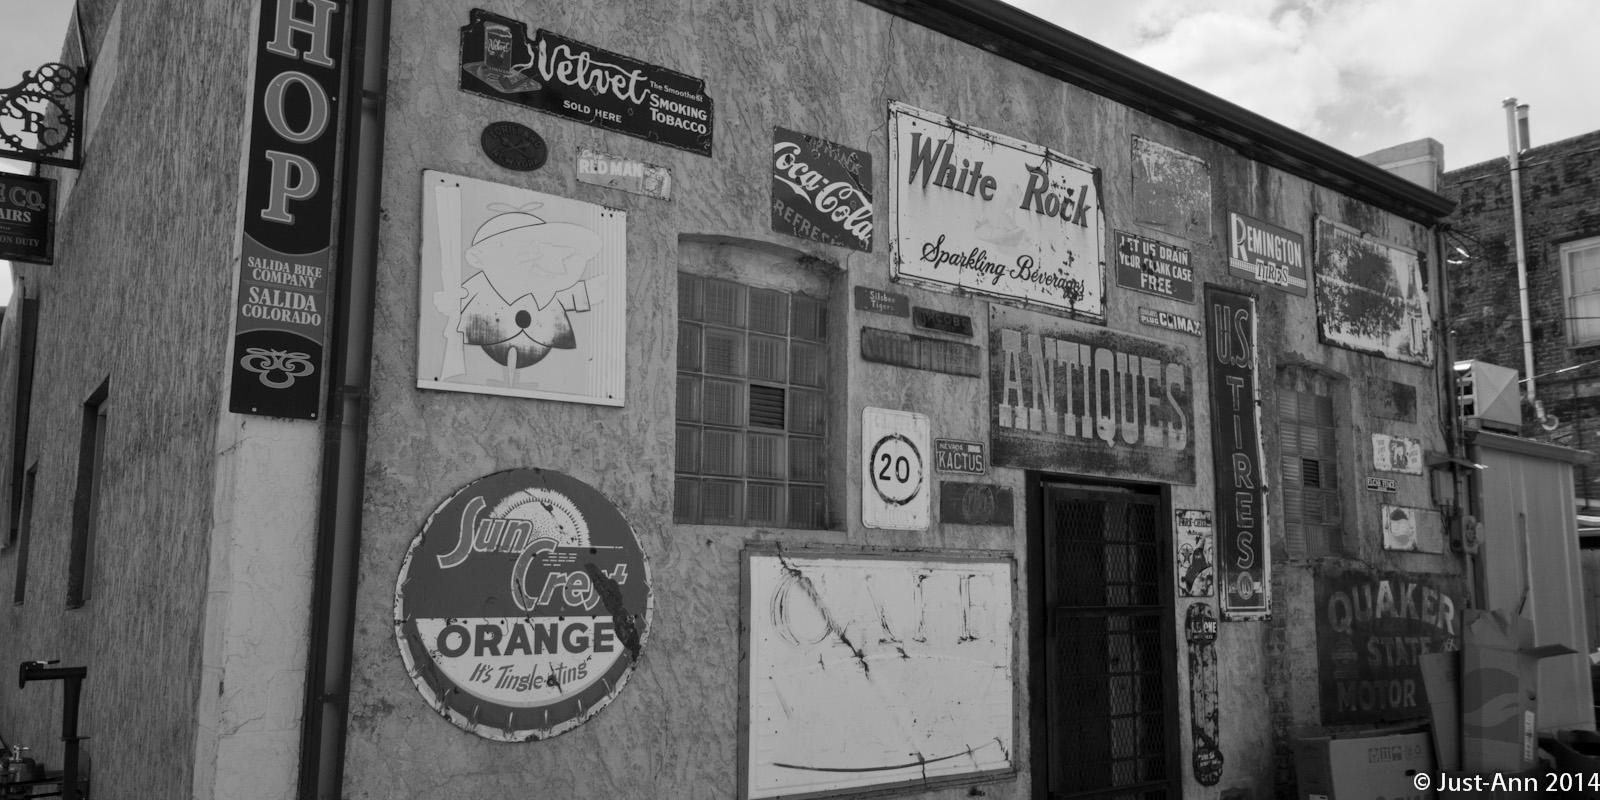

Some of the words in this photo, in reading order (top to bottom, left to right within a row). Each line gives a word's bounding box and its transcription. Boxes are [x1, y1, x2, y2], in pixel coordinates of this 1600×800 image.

[537, 38, 650, 104] Velvet
[650, 80, 663, 92] The
[562, 99, 591, 115] SOLD
[593, 107, 623, 124] HERE
[649, 93, 708, 122] SMOKING
[649, 107, 708, 135] TOBACCO
[609, 160, 645, 179] MAN
[908, 132, 998, 202] White
[1019, 161, 1092, 229] Rock
[773, 141, 873, 242] Coca-Cola
[15, 237, 40, 248] DUTY
[1142, 241, 1157, 257] US
[1159, 245, 1189, 267] DRAIN
[1230, 212, 1304, 269] REMINGTON
[247, 256, 291, 274] SALIDA
[294, 263, 323, 279] BIKE
[252, 268, 317, 289] COMPANY
[920, 242, 1006, 286] Sparkling
[1010, 254, 1085, 301] Beverages
[1118, 250, 1141, 270] YOUR
[1172, 265, 1193, 283] CASE
[1255, 258, 1289, 287] TIRES
[1140, 272, 1173, 295] FREE
[247, 286, 318, 313] SALIDA
[241, 303, 322, 327] COLORADO
[1159, 312, 1202, 337] CLIMAX
[1213, 303, 1253, 371] U.S.
[998, 327, 1189, 452] ANTIQUES
[878, 452, 911, 484] 20
[938, 451, 983, 472] KACTUS
[1226, 375, 1255, 569] TIRES
[437, 496, 534, 569] Sun
[1327, 579, 1456, 637] QUAKER
[436, 622, 615, 658] ORANGE
[469, 663, 495, 684] It's
[1336, 678, 1418, 713] MOTOR
